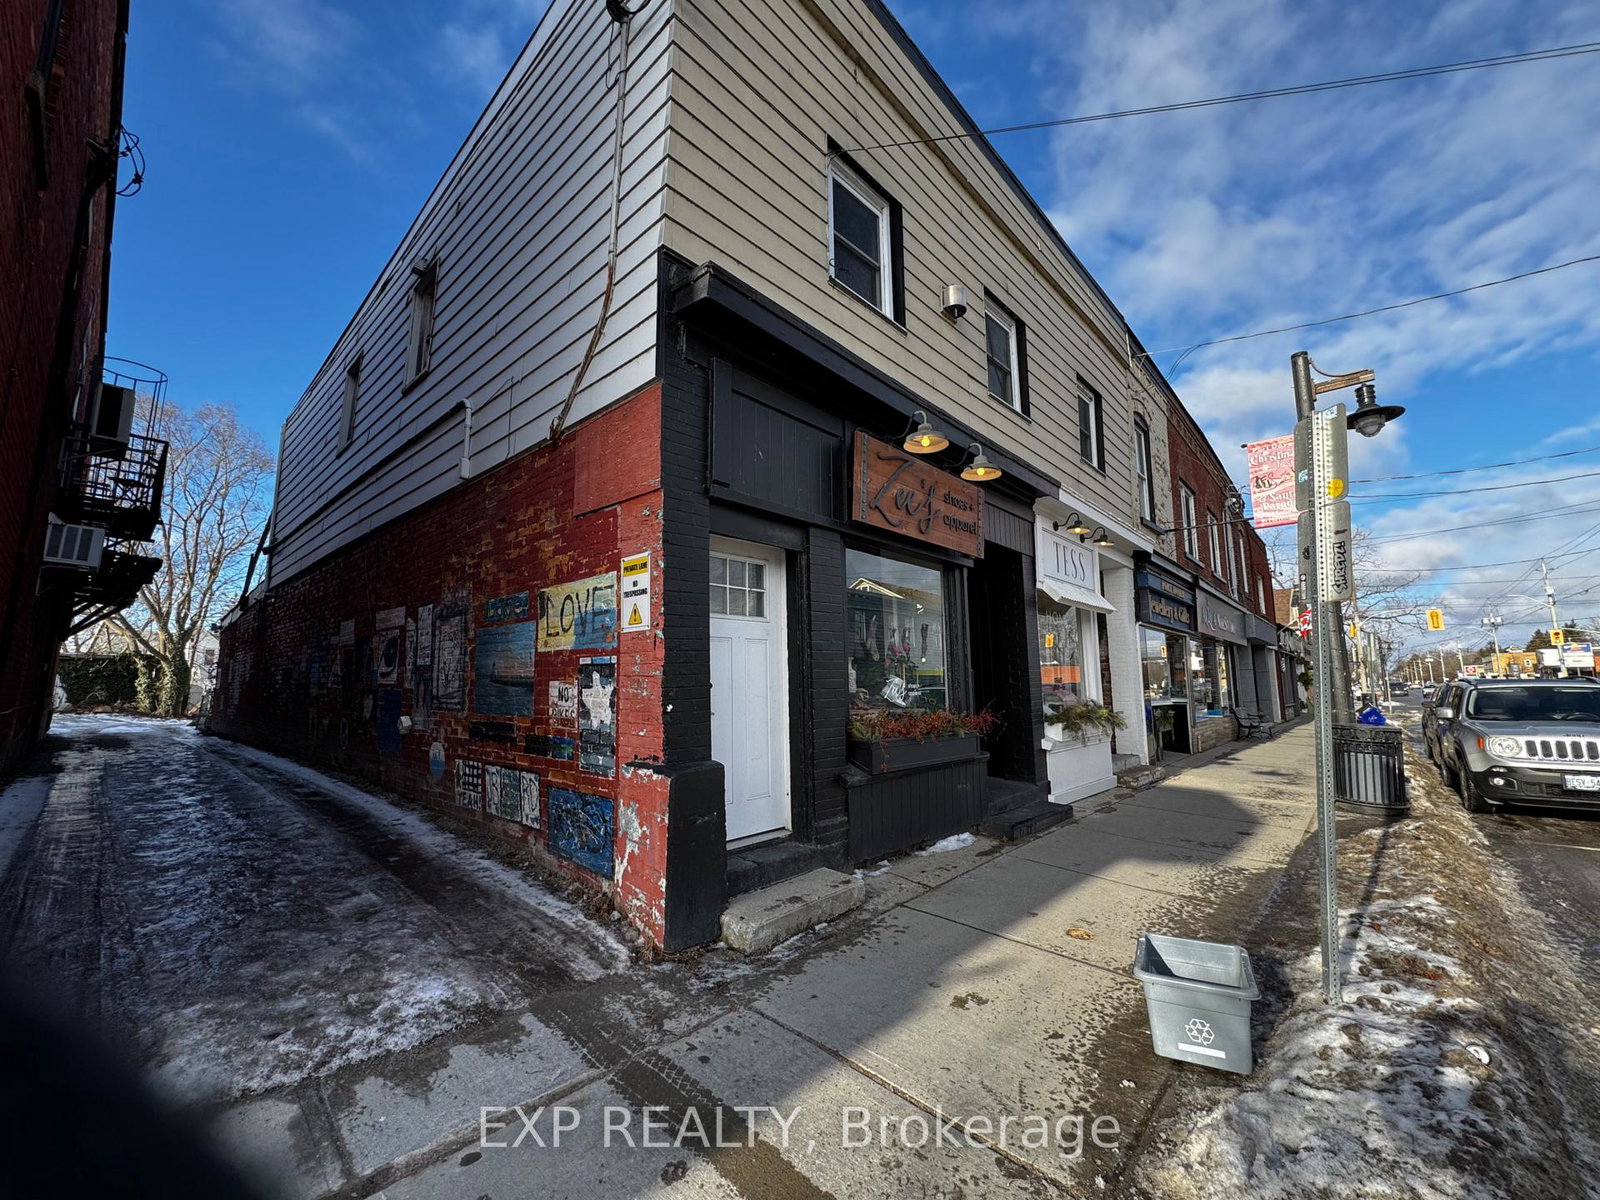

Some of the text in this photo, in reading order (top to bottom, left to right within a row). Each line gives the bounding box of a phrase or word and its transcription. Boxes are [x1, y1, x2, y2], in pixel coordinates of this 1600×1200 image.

[943, 514, 977, 535] apparel
[1053, 541, 1086, 582] TESS
[623, 588, 648, 598] TRESPASSING
[632, 580, 638, 588] NO
[545, 584, 615, 637] LOVE
[557, 685, 570, 703] NO
